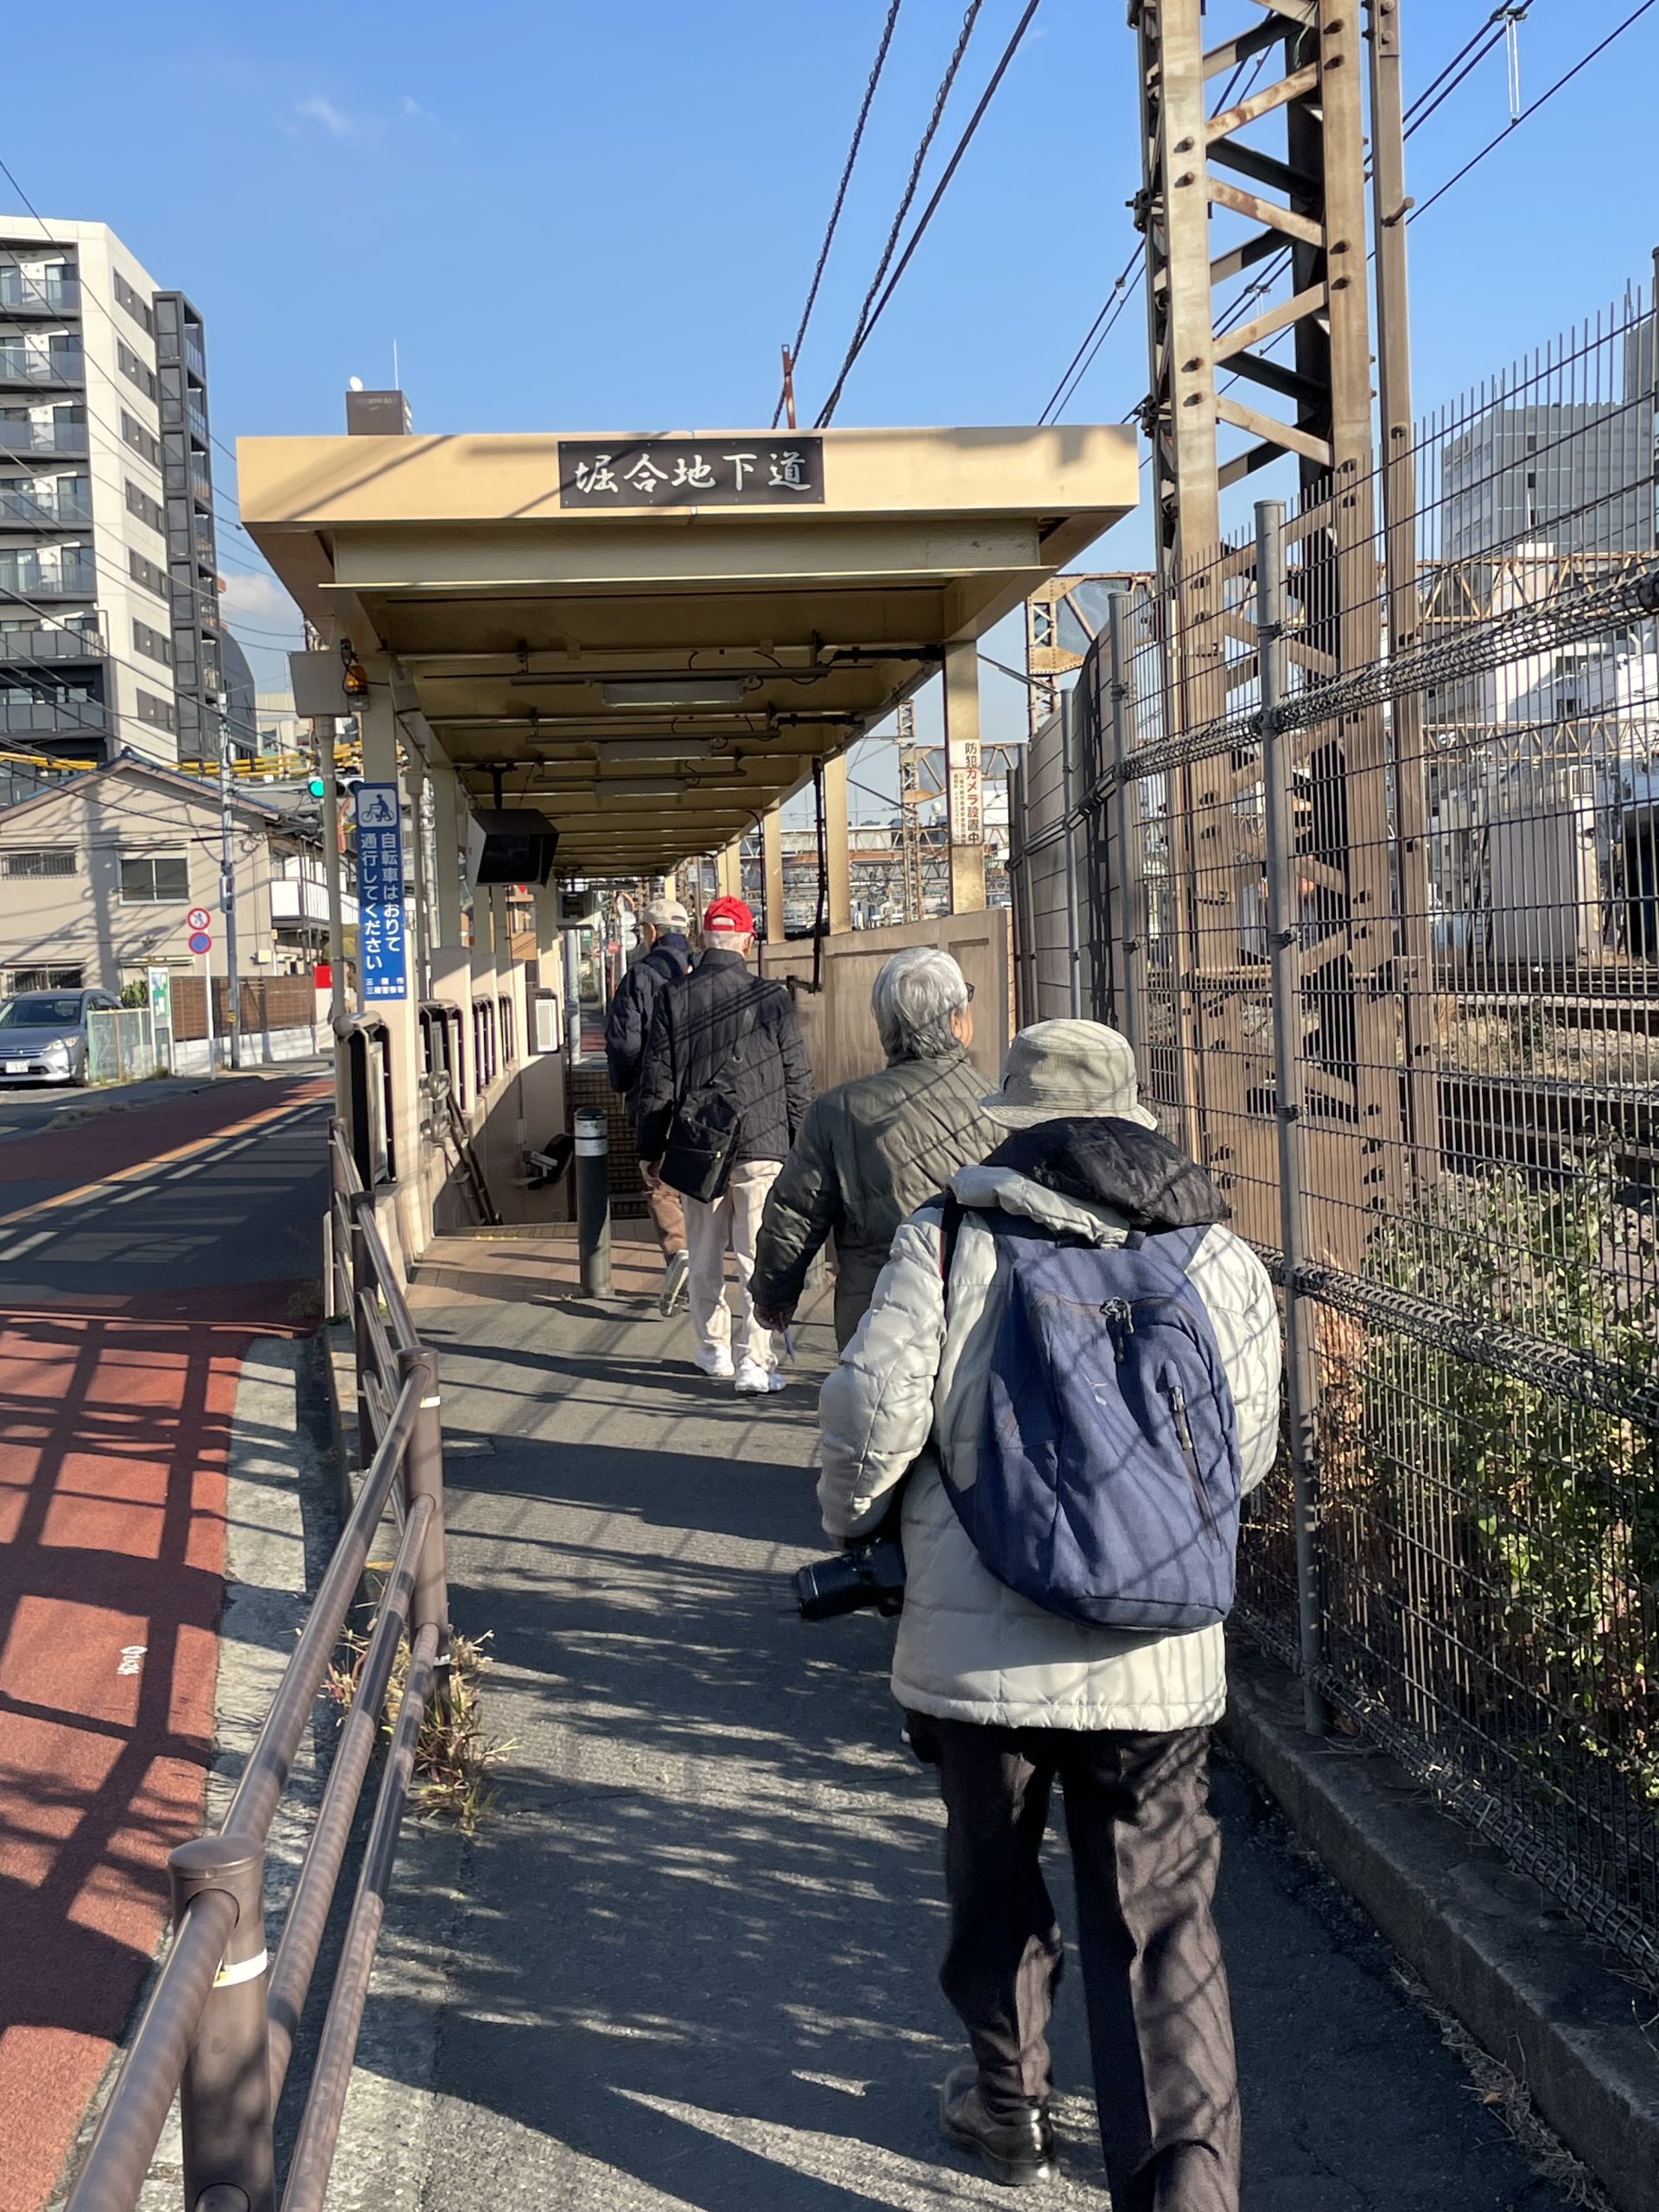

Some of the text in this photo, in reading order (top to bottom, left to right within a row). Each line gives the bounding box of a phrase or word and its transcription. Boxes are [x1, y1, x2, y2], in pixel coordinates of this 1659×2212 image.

[575, 451, 811, 493] 堀合地下道
[361, 833, 383, 969] 通行してください
[381, 832, 401, 952] 自転車はおりて
